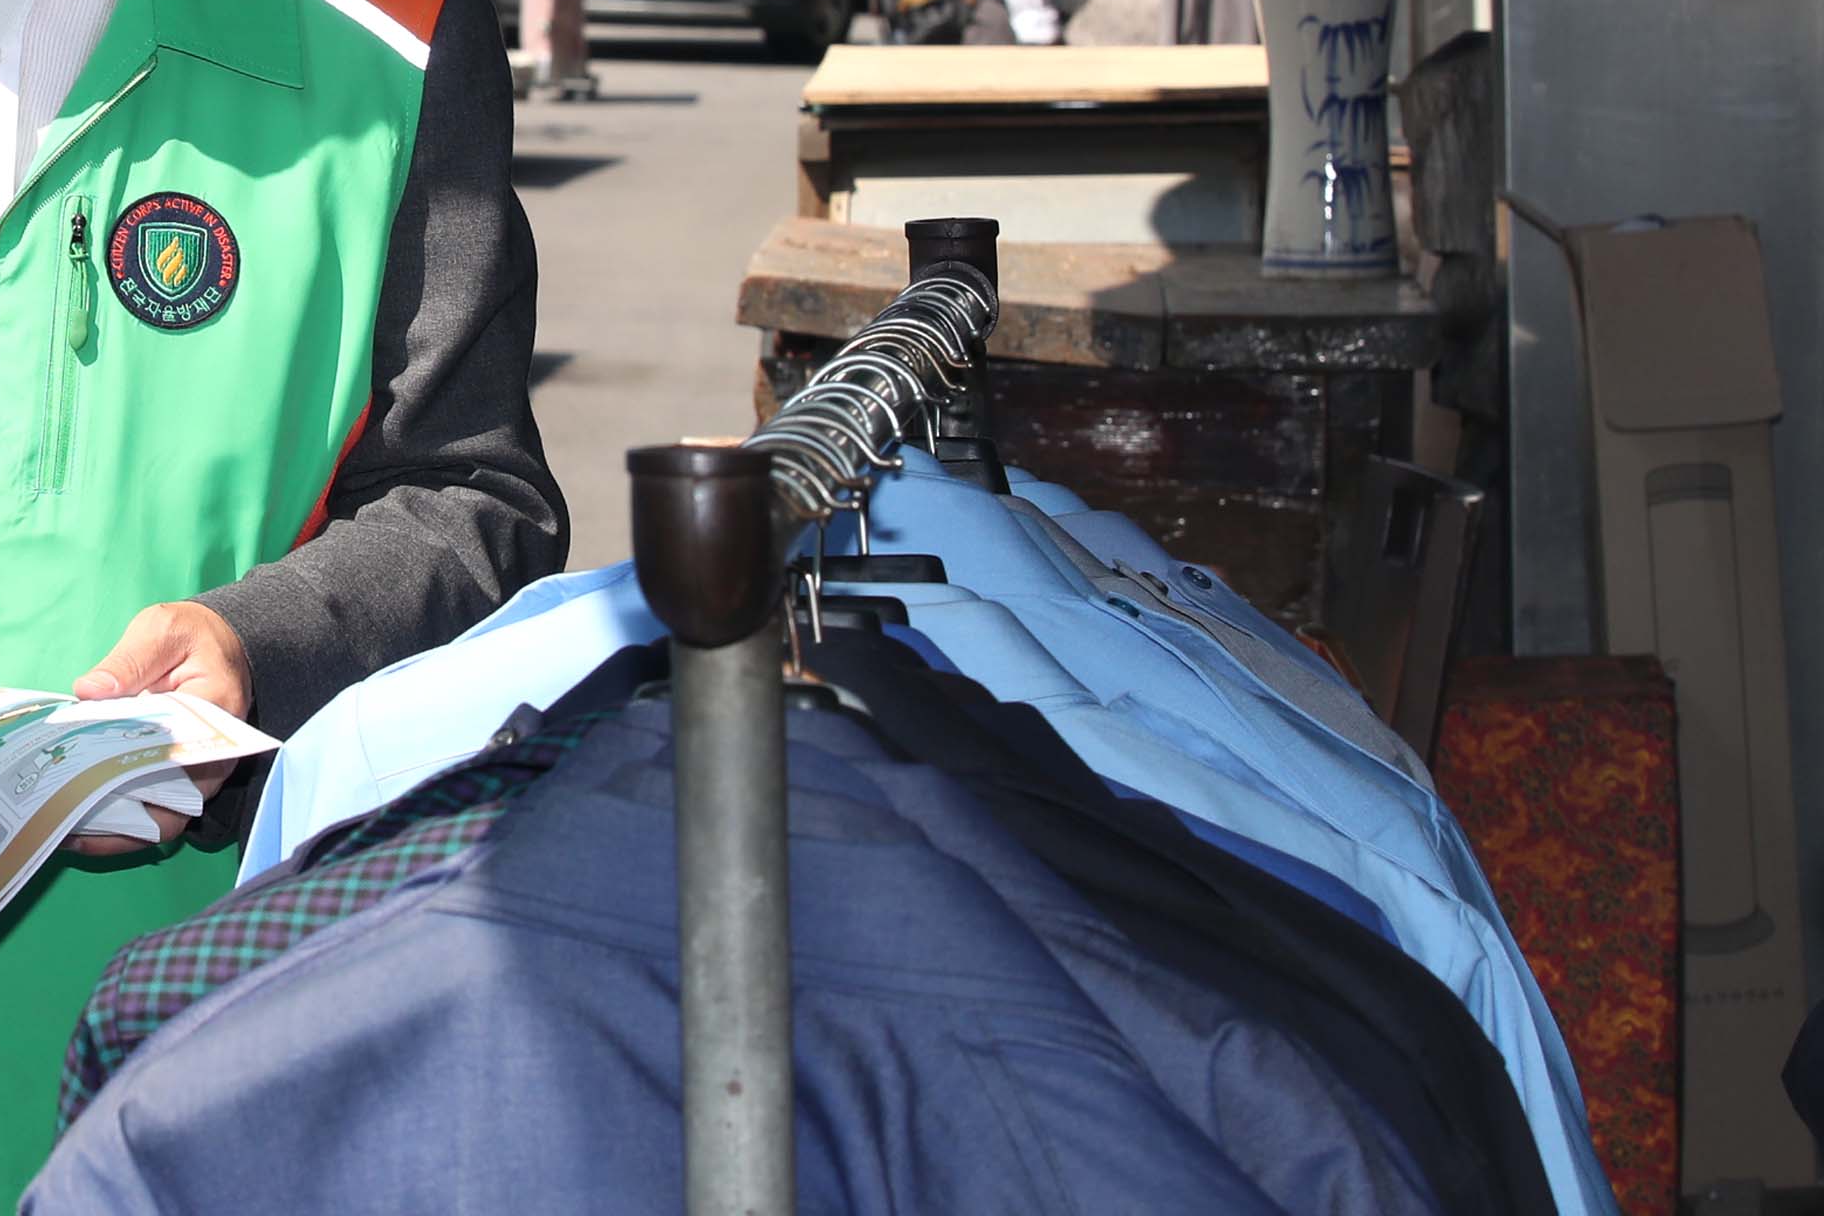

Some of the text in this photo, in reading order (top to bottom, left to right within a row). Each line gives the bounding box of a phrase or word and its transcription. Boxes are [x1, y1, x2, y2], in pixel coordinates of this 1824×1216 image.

[126, 199, 162, 226] CORPS
[164, 197, 205, 216] ACTIVE
[202, 213, 218, 227] IN
[213, 226, 236, 280] DISASTER
[119, 277, 222, 322] 전국자율방재단
